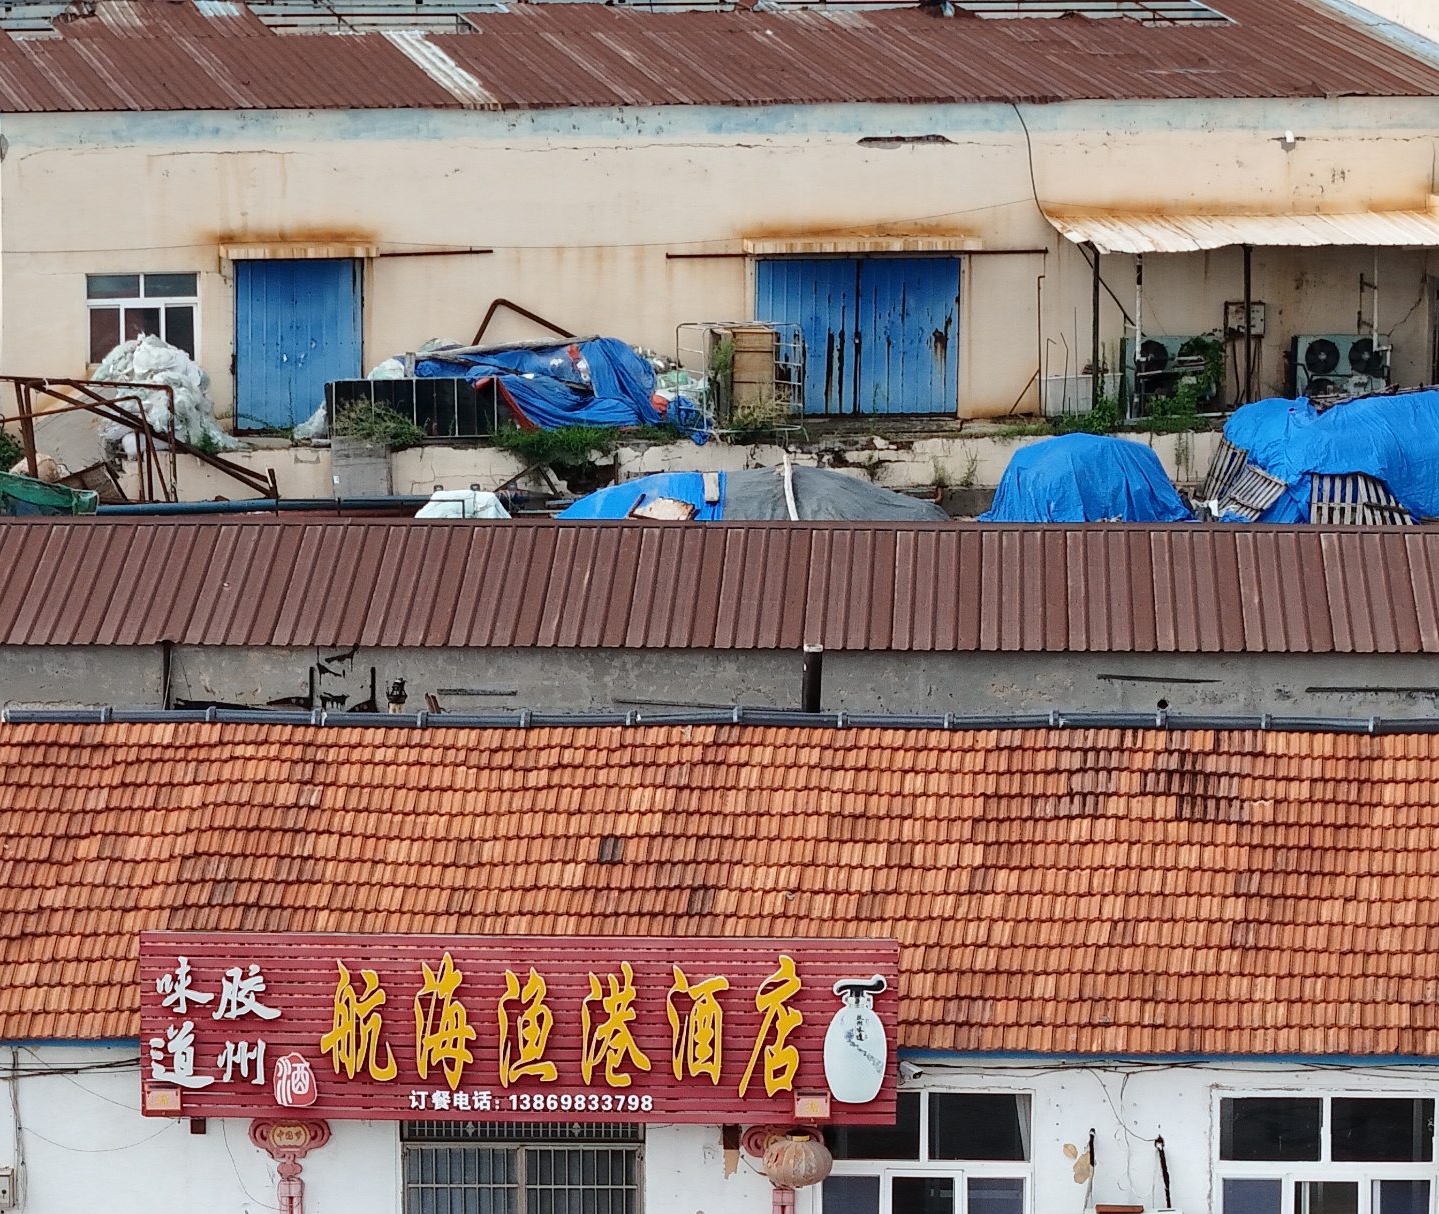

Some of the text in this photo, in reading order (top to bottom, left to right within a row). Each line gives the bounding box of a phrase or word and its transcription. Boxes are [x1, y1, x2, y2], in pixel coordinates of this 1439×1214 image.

[149, 956, 215, 1088] 味道
[212, 963, 282, 1085] 胶州
[321, 953, 803, 1097] 航海渔港酒店
